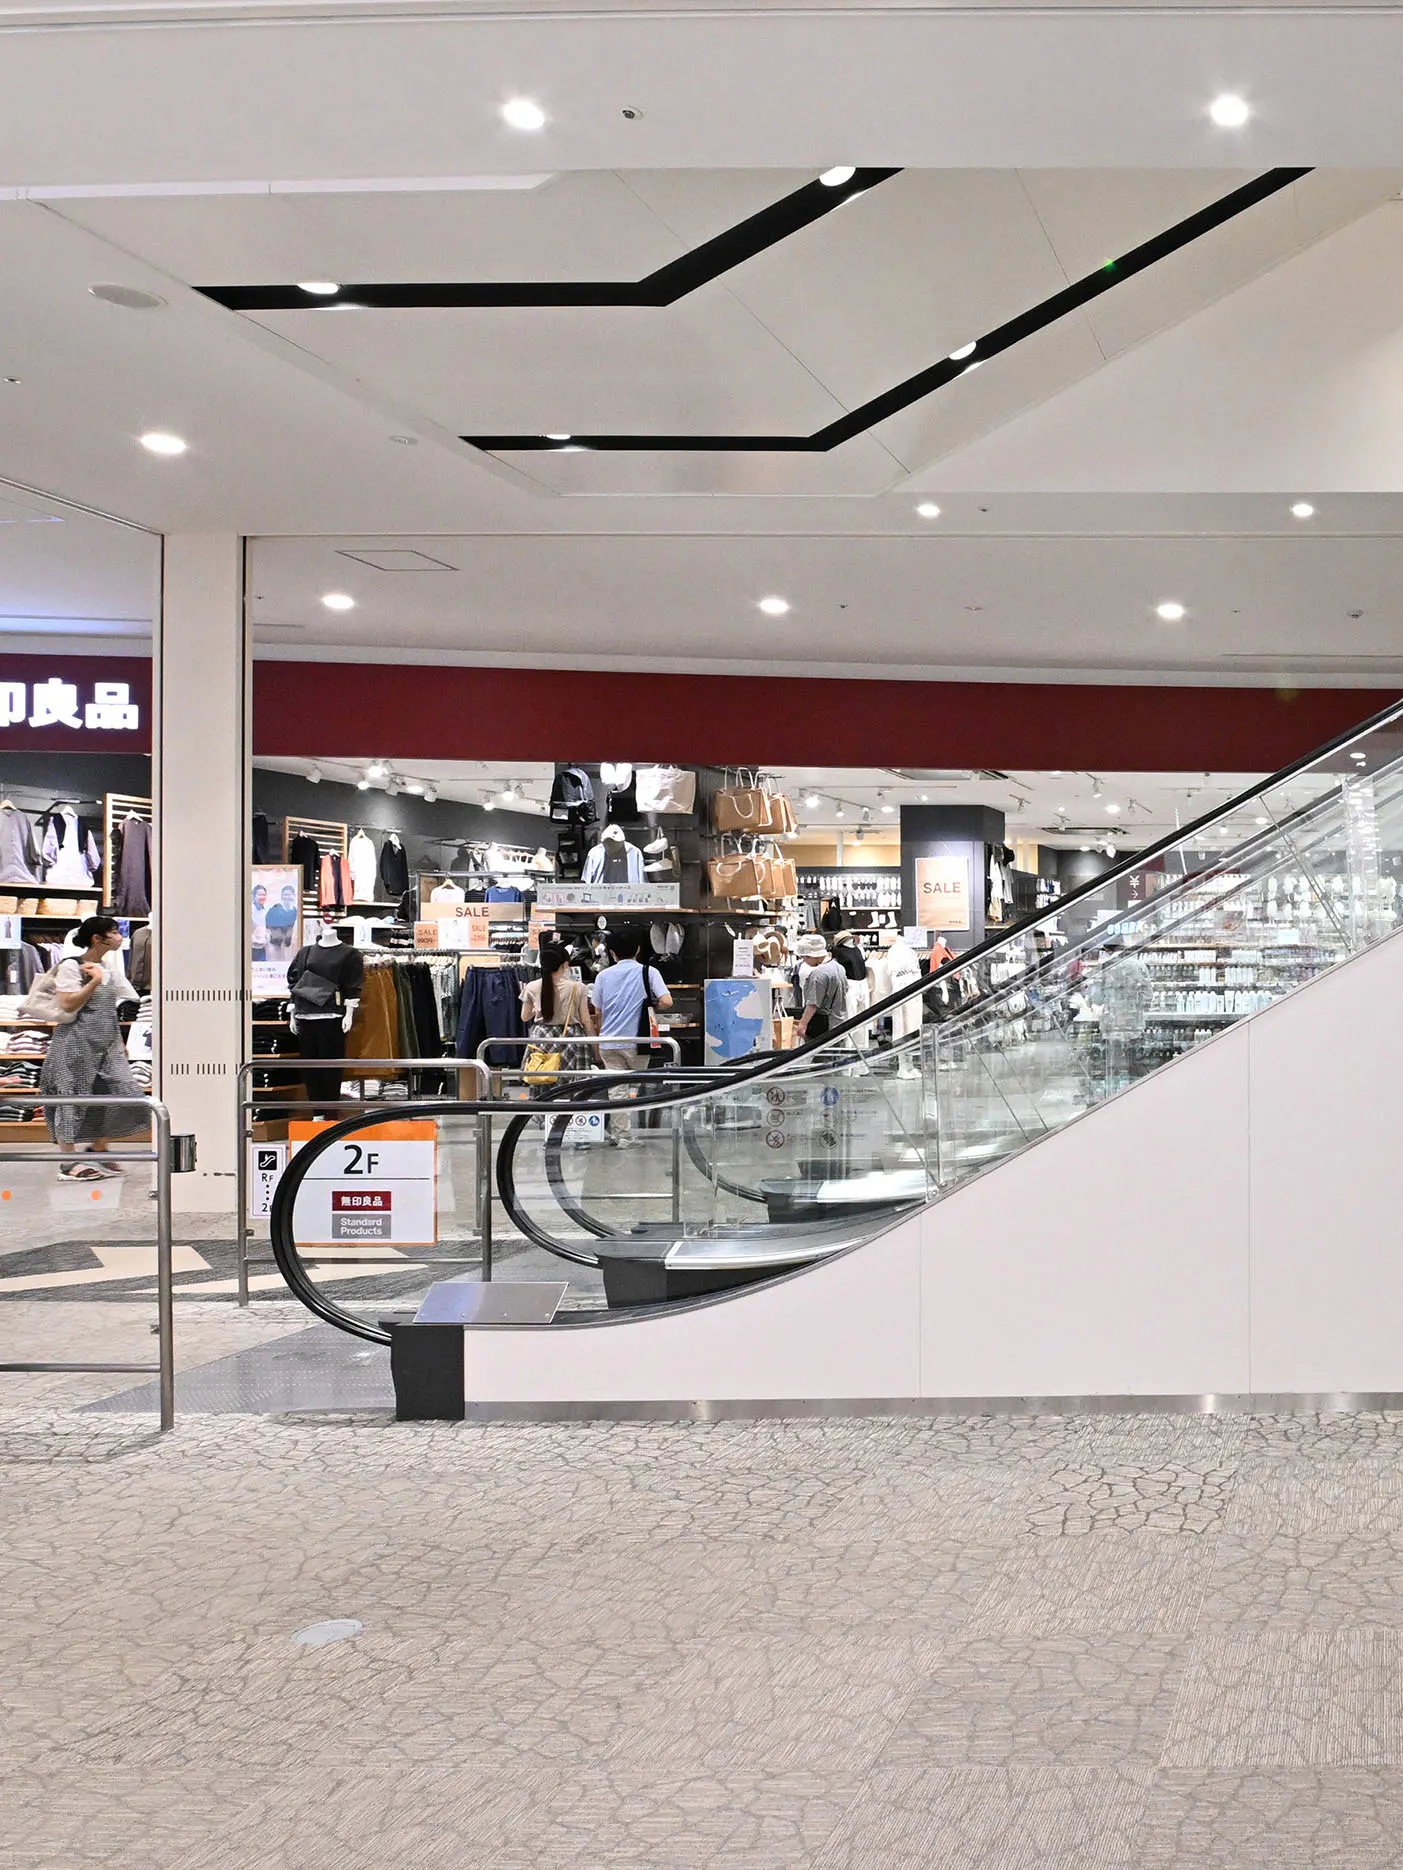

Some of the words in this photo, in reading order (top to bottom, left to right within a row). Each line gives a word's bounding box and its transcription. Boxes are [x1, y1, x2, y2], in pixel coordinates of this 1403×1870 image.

[923, 882, 961, 894] SALE
[455, 907, 490, 917] SALE
[343, 1144, 380, 1175] 2F
[261, 1172, 275, 1182] RF
[340, 1196, 384, 1207] 無印良品
[340, 1217, 383, 1226] Standard
[340, 1226, 383, 1236] Products
